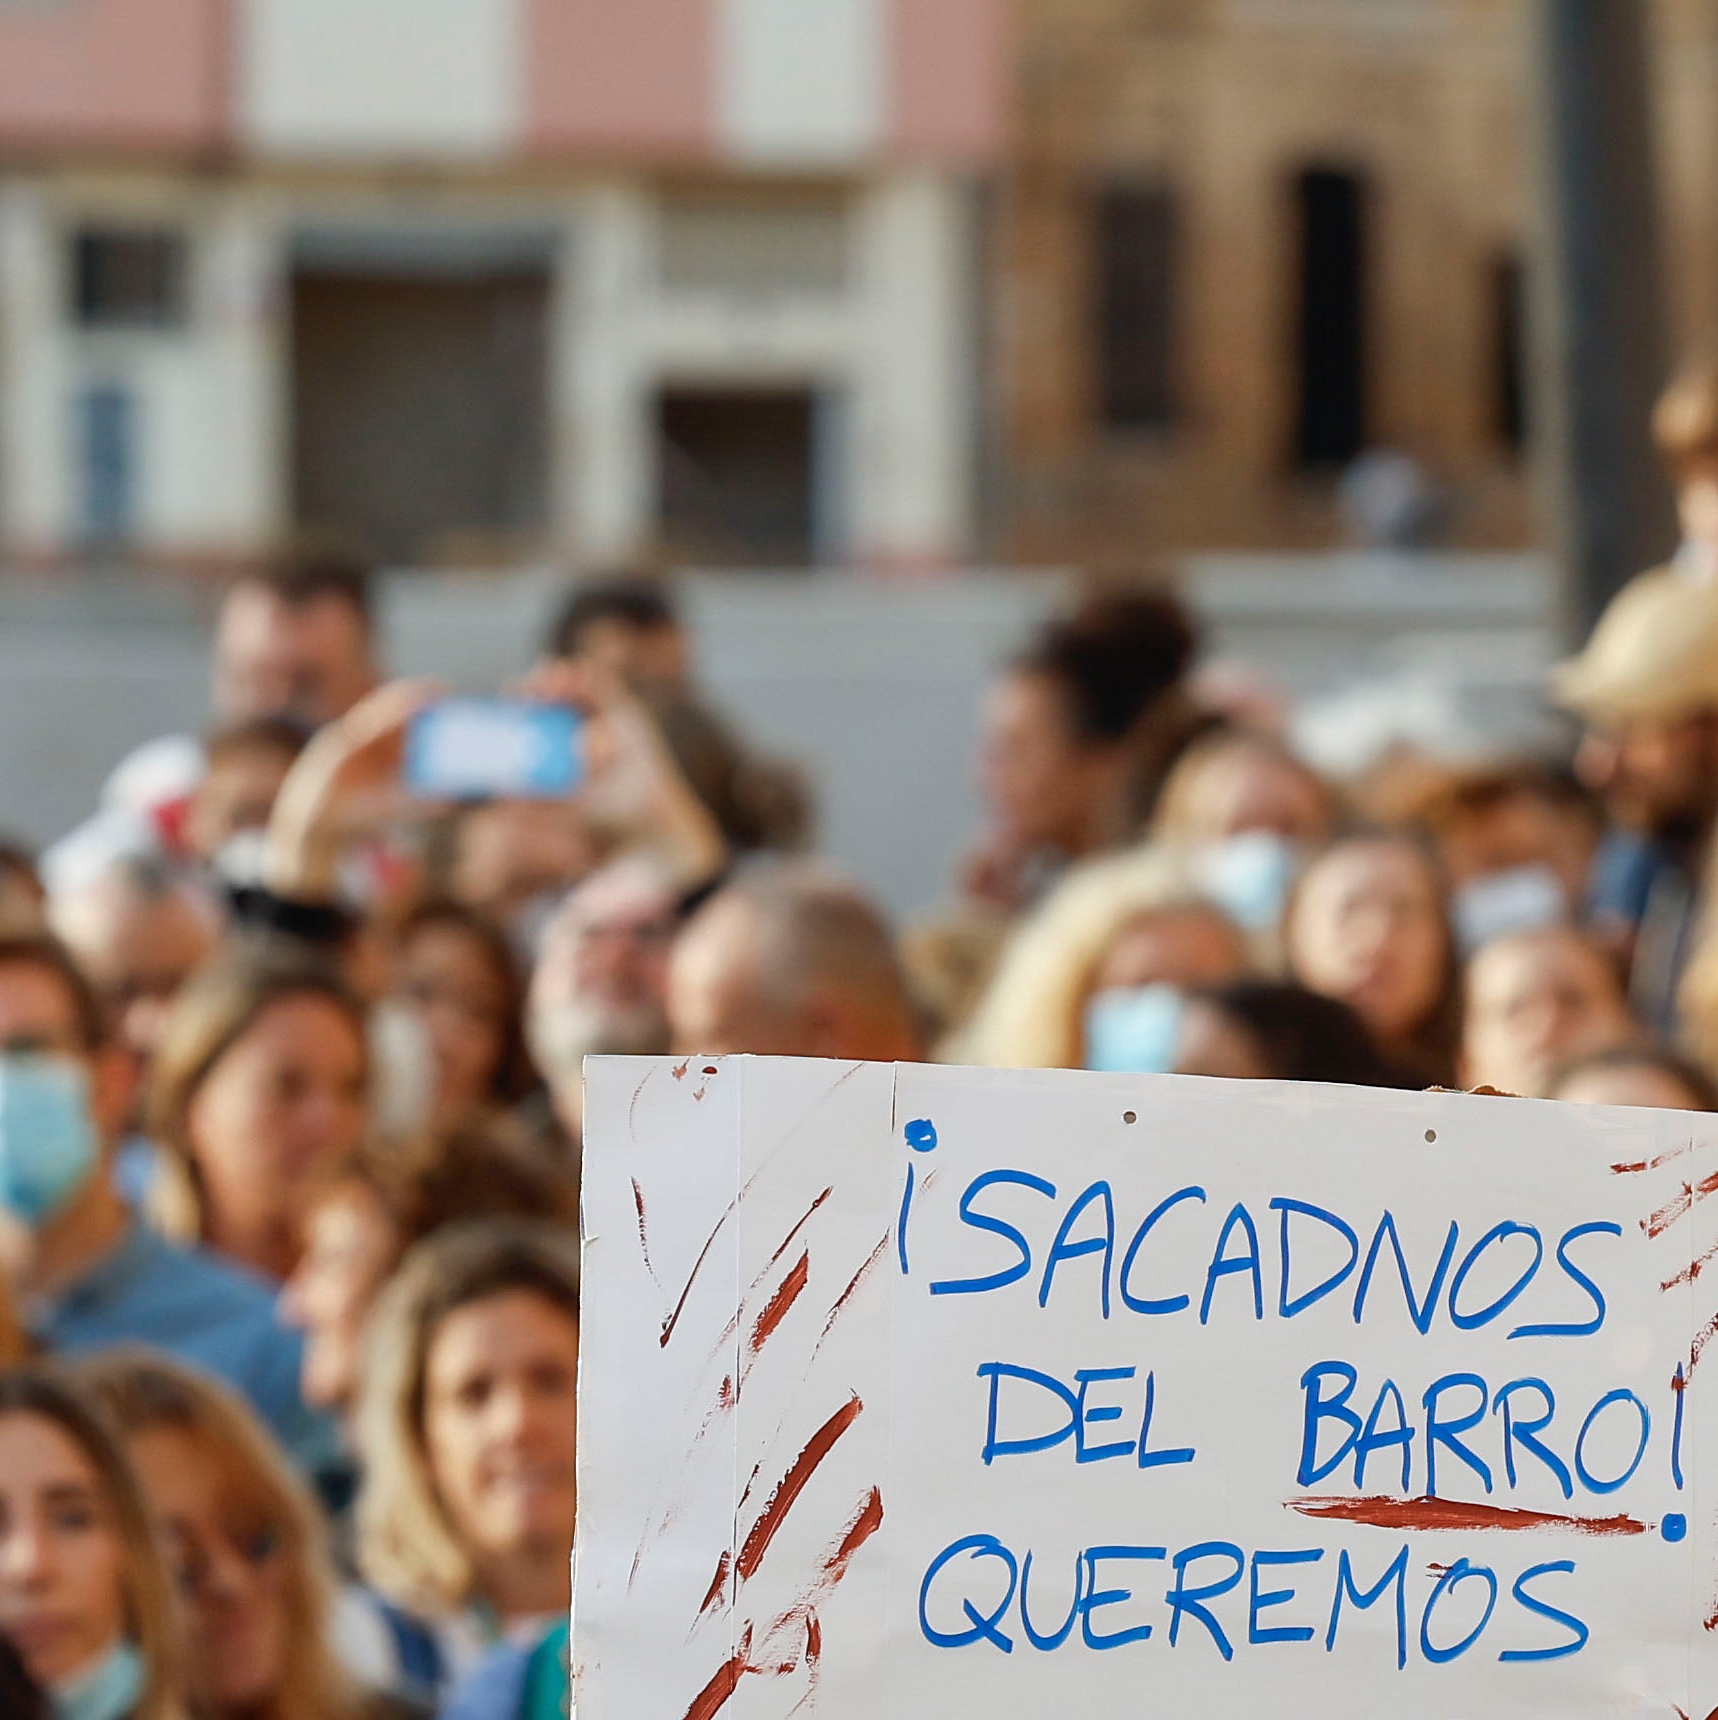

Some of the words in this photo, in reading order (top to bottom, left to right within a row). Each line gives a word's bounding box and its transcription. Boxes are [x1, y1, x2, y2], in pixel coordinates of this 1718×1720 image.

[896, 1117, 1624, 1342] ¡SACADNOS
[974, 1359, 1198, 1471] DEL
[1295, 1358, 1689, 1545] BARRO!
[917, 1531, 1591, 1672] QUEREMOS
